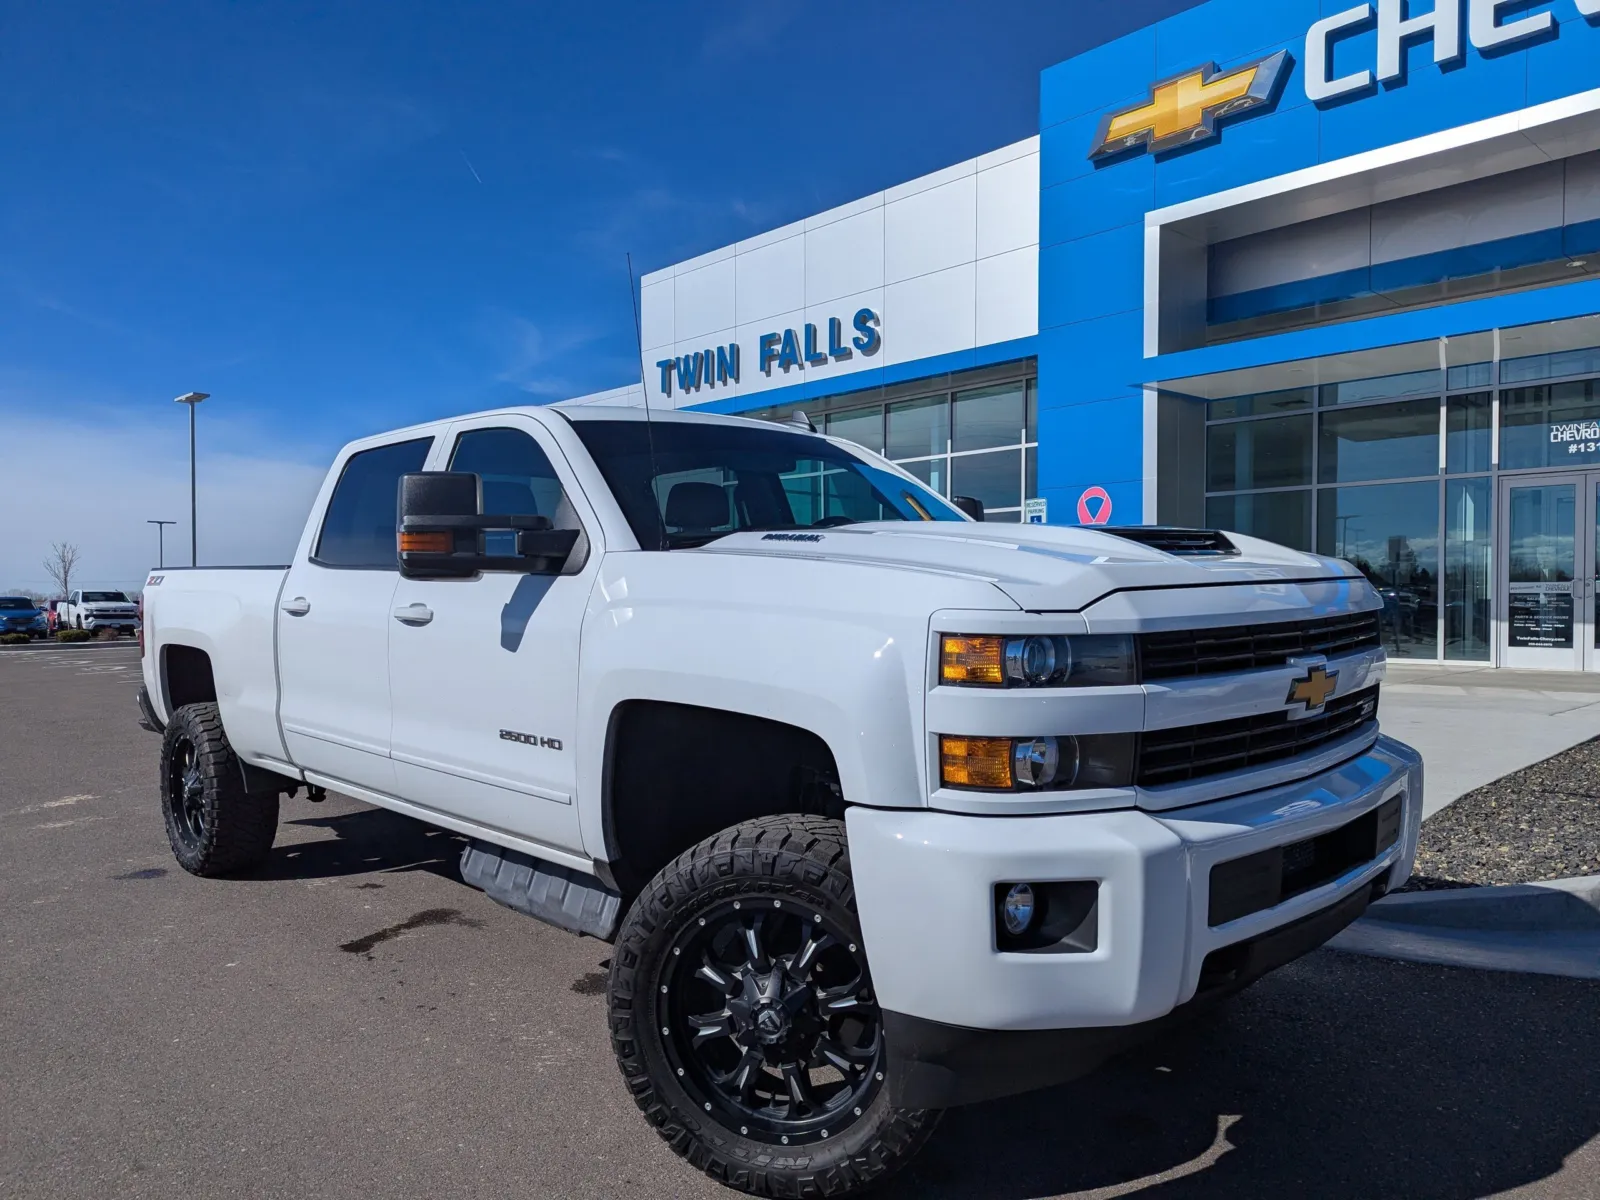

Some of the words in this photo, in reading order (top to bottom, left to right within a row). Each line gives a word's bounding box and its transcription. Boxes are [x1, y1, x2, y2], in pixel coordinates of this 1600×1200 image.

[1304, 0, 1600, 102] CHE
[656, 342, 740, 398] TWIN
[759, 307, 882, 377] FALLS
[1550, 427, 1600, 443] CHEVRO
[499, 728, 538, 746] 2500
[540, 735, 563, 751] HD
